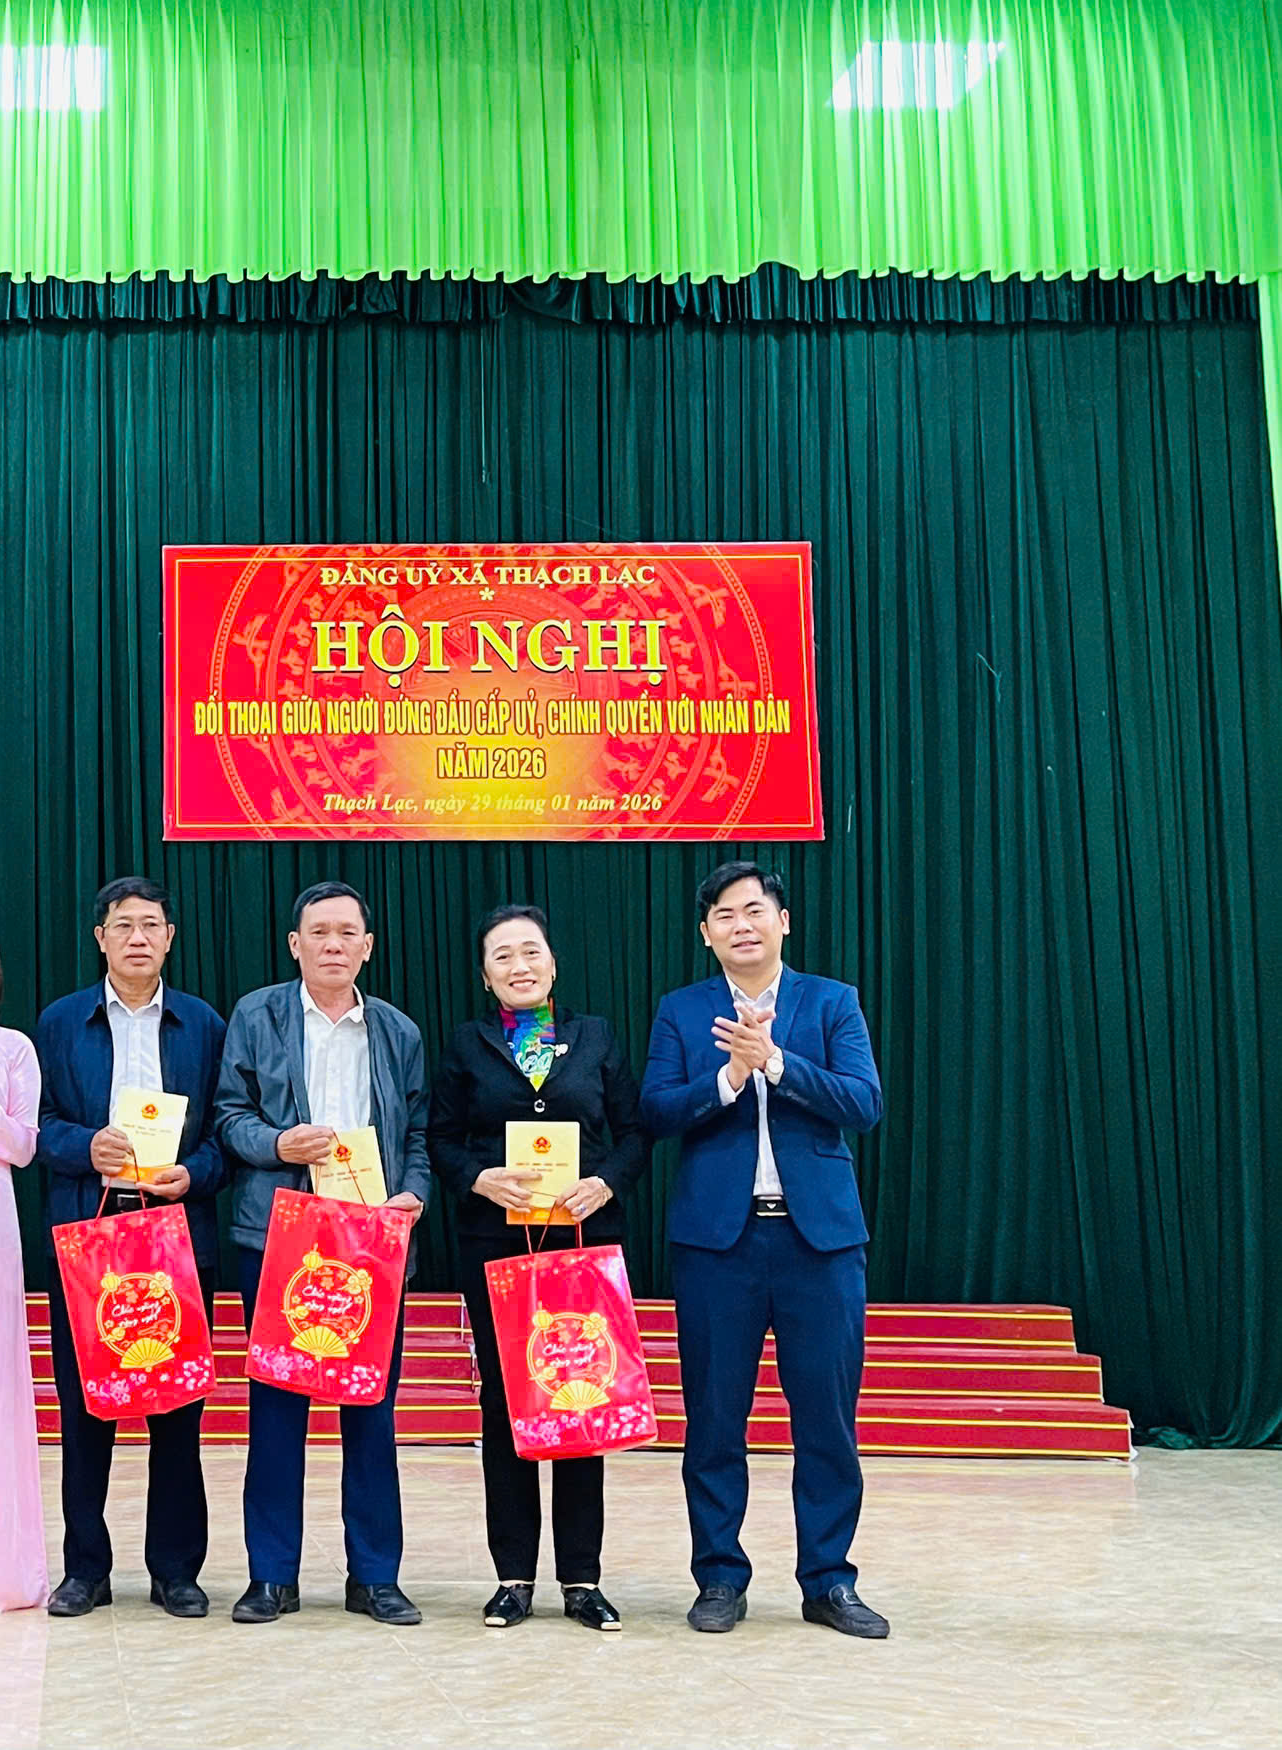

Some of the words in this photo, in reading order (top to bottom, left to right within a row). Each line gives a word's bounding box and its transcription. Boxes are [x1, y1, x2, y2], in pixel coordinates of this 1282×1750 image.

[320, 562, 398, 586] ĐẢNG
[405, 562, 443, 586] UỶ
[449, 562, 489, 585] XÃ
[494, 565, 592, 589] THẠCH
[598, 565, 655, 589] LẠC
[311, 603, 450, 688] HỘI
[470, 619, 668, 685] NGHỊ
[194, 690, 223, 735] ĐỐI
[228, 701, 277, 742] THOẠI
[282, 695, 323, 735] GIỮA
[327, 692, 380, 735] NGƯỜI
[384, 693, 432, 735] ĐỨNG
[435, 688, 472, 735] ĐẦU
[475, 687, 511, 735] CẤP
[515, 688, 543, 738] UỶ,
[546, 693, 601, 735] CHÍNH
[605, 689, 663, 737] QUYỀN
[667, 693, 696, 735] VỚI
[700, 693, 750, 734] NHÂN
[754, 693, 791, 734] DÂN
[436, 742, 489, 779] NĂM
[492, 747, 547, 779] 2026
[323, 794, 377, 815] Thạch
[382, 794, 419, 815] Lạc,
[424, 794, 465, 815] ngày
[470, 794, 491, 811] 29
[496, 794, 547, 815] tháng
[551, 794, 571, 811] 01
[576, 794, 616, 811] năm
[620, 794, 663, 811] 2026
